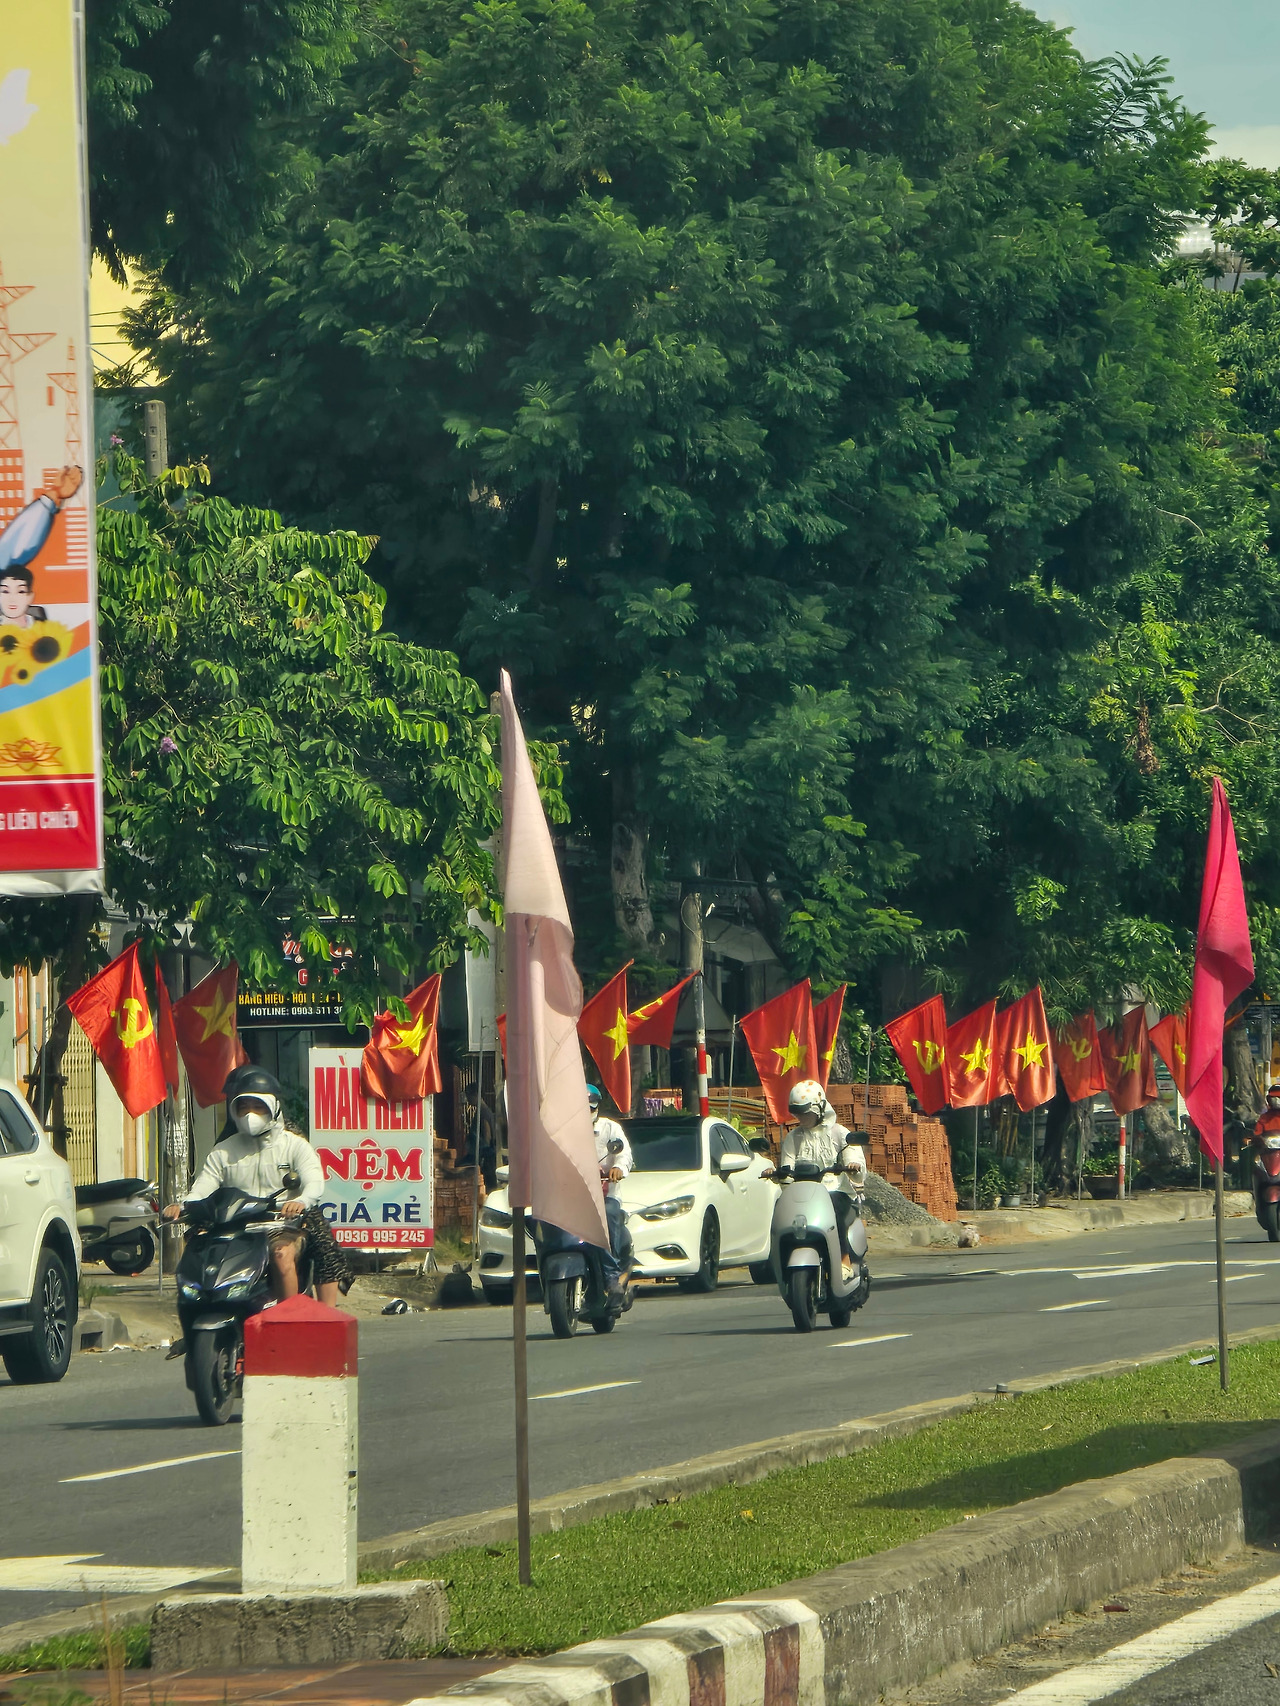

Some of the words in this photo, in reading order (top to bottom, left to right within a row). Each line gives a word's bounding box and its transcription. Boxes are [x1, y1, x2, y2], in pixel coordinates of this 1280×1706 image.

[7, 808, 38, 831] LIÊN
[250, 1007, 290, 1016] HOTLINE:
[291, 1006, 313, 1015] 0903
[315, 1006, 331, 1015] 511
[315, 1055, 368, 1130] MÀN
[315, 1138, 424, 1190] NỆM
[320, 1197, 373, 1223] GIÁ
[382, 1195, 422, 1223] RẺ
[336, 1230, 369, 1243] 0936
[373, 1230, 398, 1243] 995
[401, 1230, 425, 1243] 245
